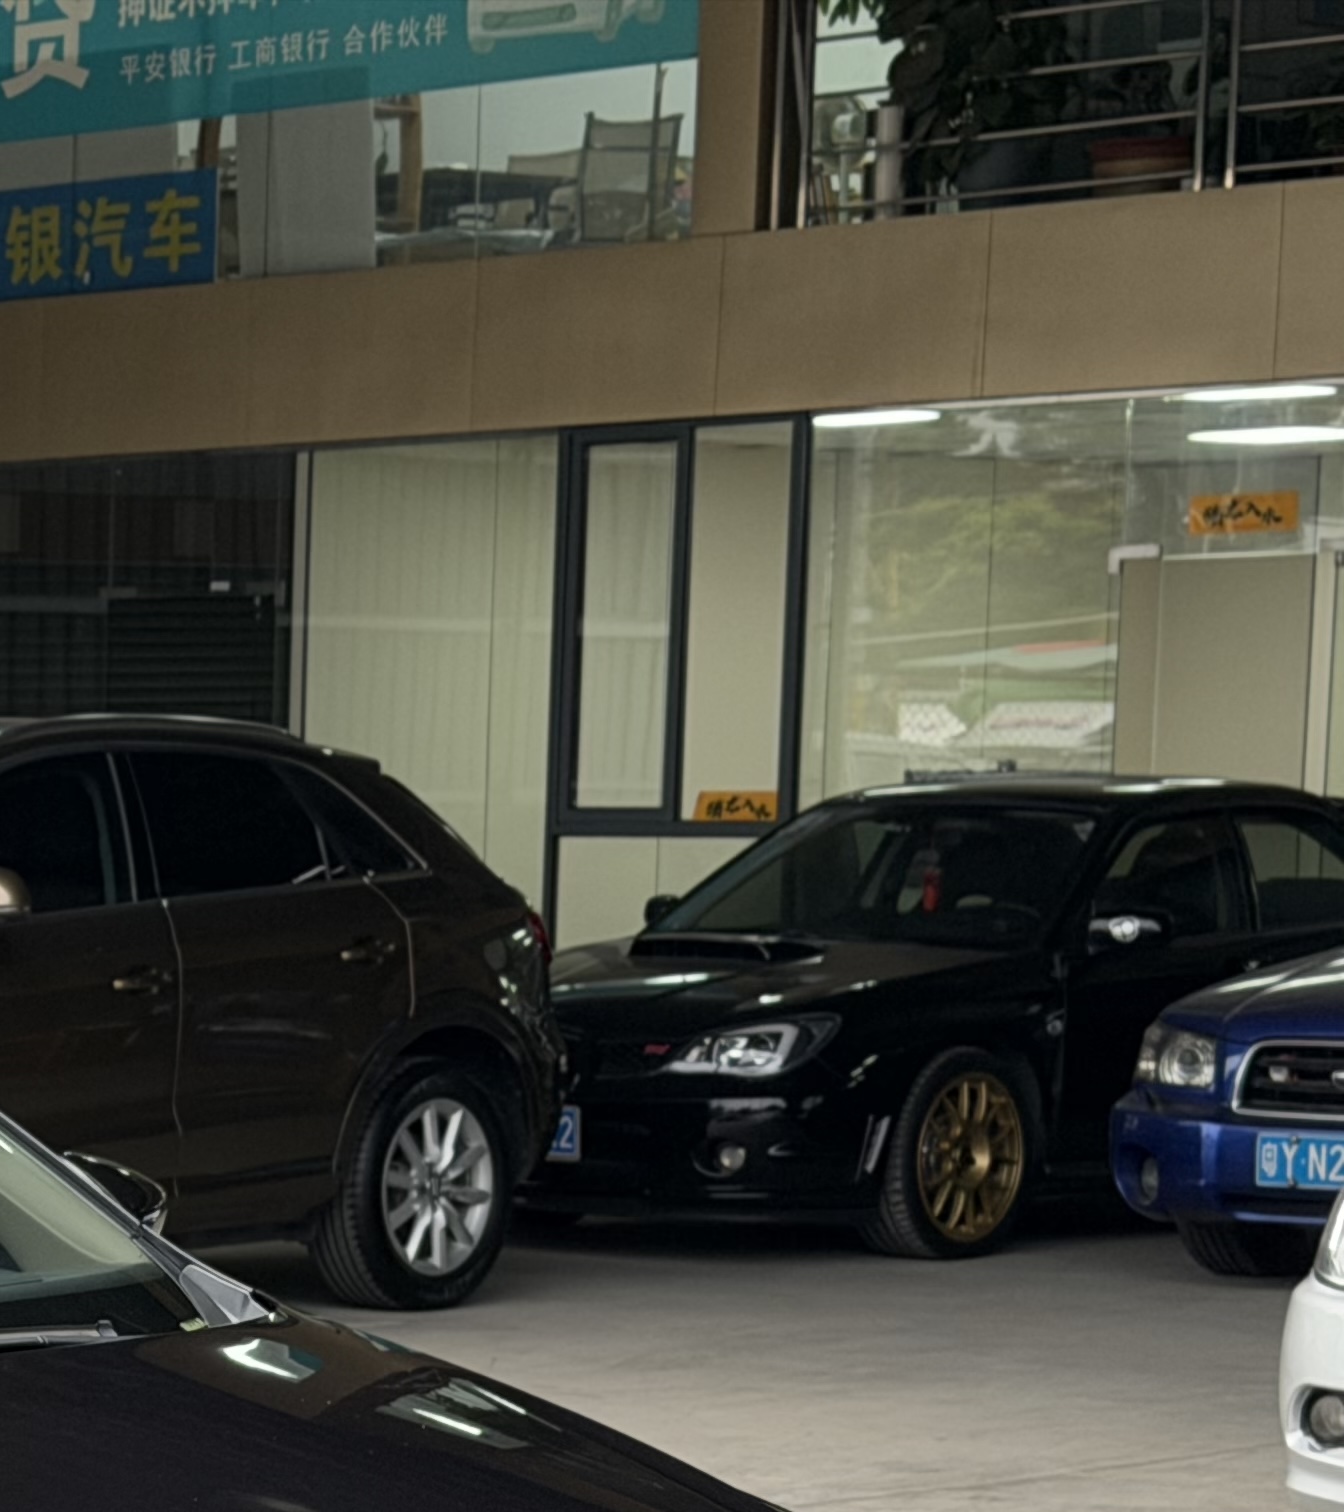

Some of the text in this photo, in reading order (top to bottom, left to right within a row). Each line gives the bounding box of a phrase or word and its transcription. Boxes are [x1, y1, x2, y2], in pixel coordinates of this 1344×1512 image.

[119, 12, 448, 86] 平安银行 工商银行 合作伙伴
